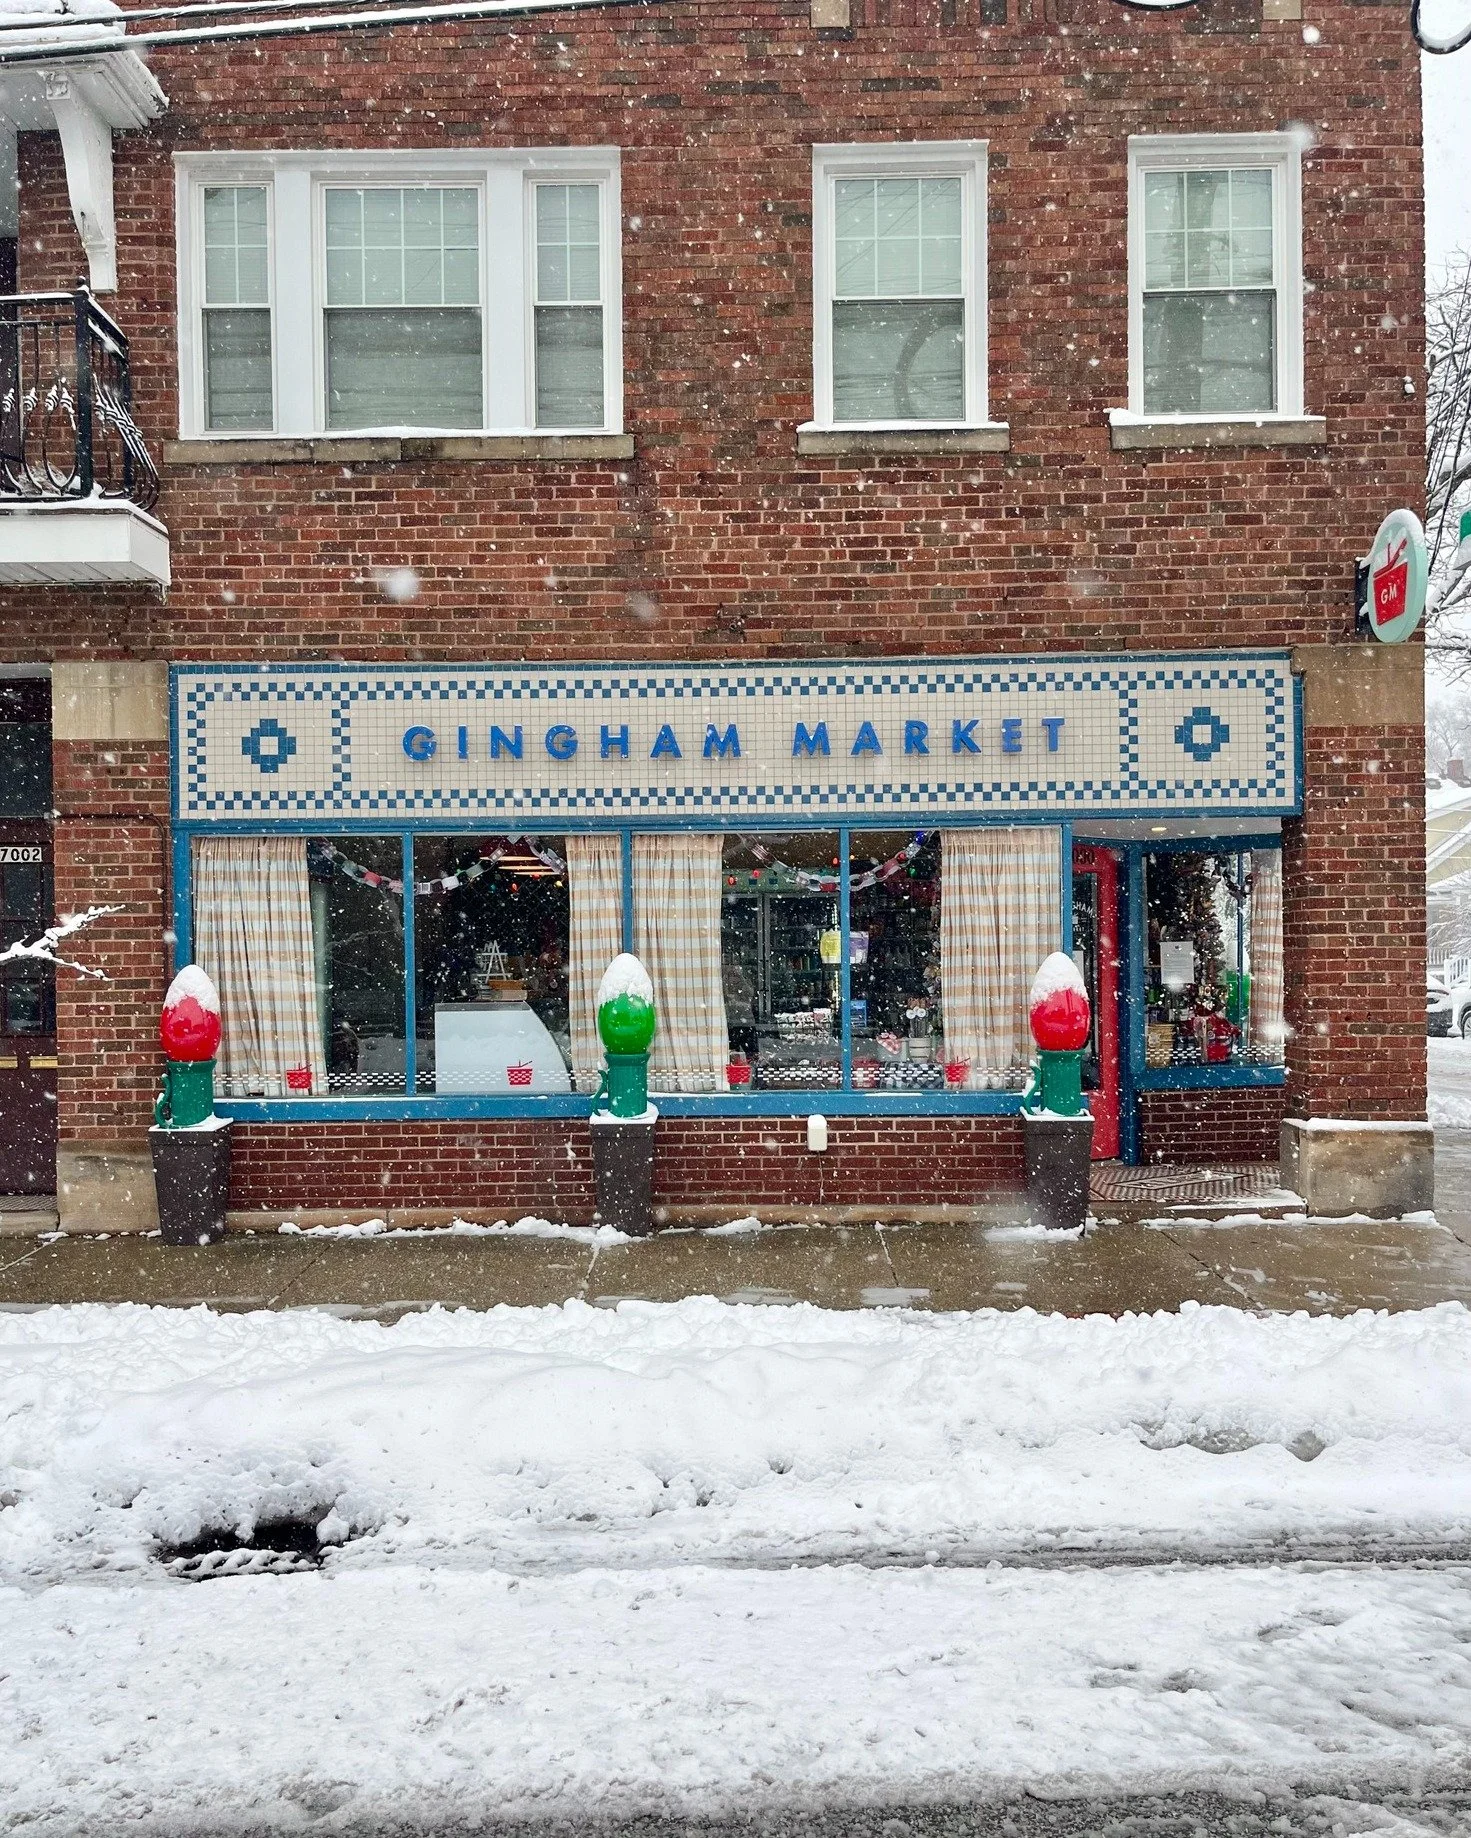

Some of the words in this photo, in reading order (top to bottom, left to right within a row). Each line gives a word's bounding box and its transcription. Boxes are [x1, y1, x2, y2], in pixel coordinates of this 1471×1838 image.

[1381, 584, 1397, 604] GM
[402, 723, 742, 760] GINGHAM
[792, 717, 1066, 757] MARKET
[0, 848, 41, 861] 7002
